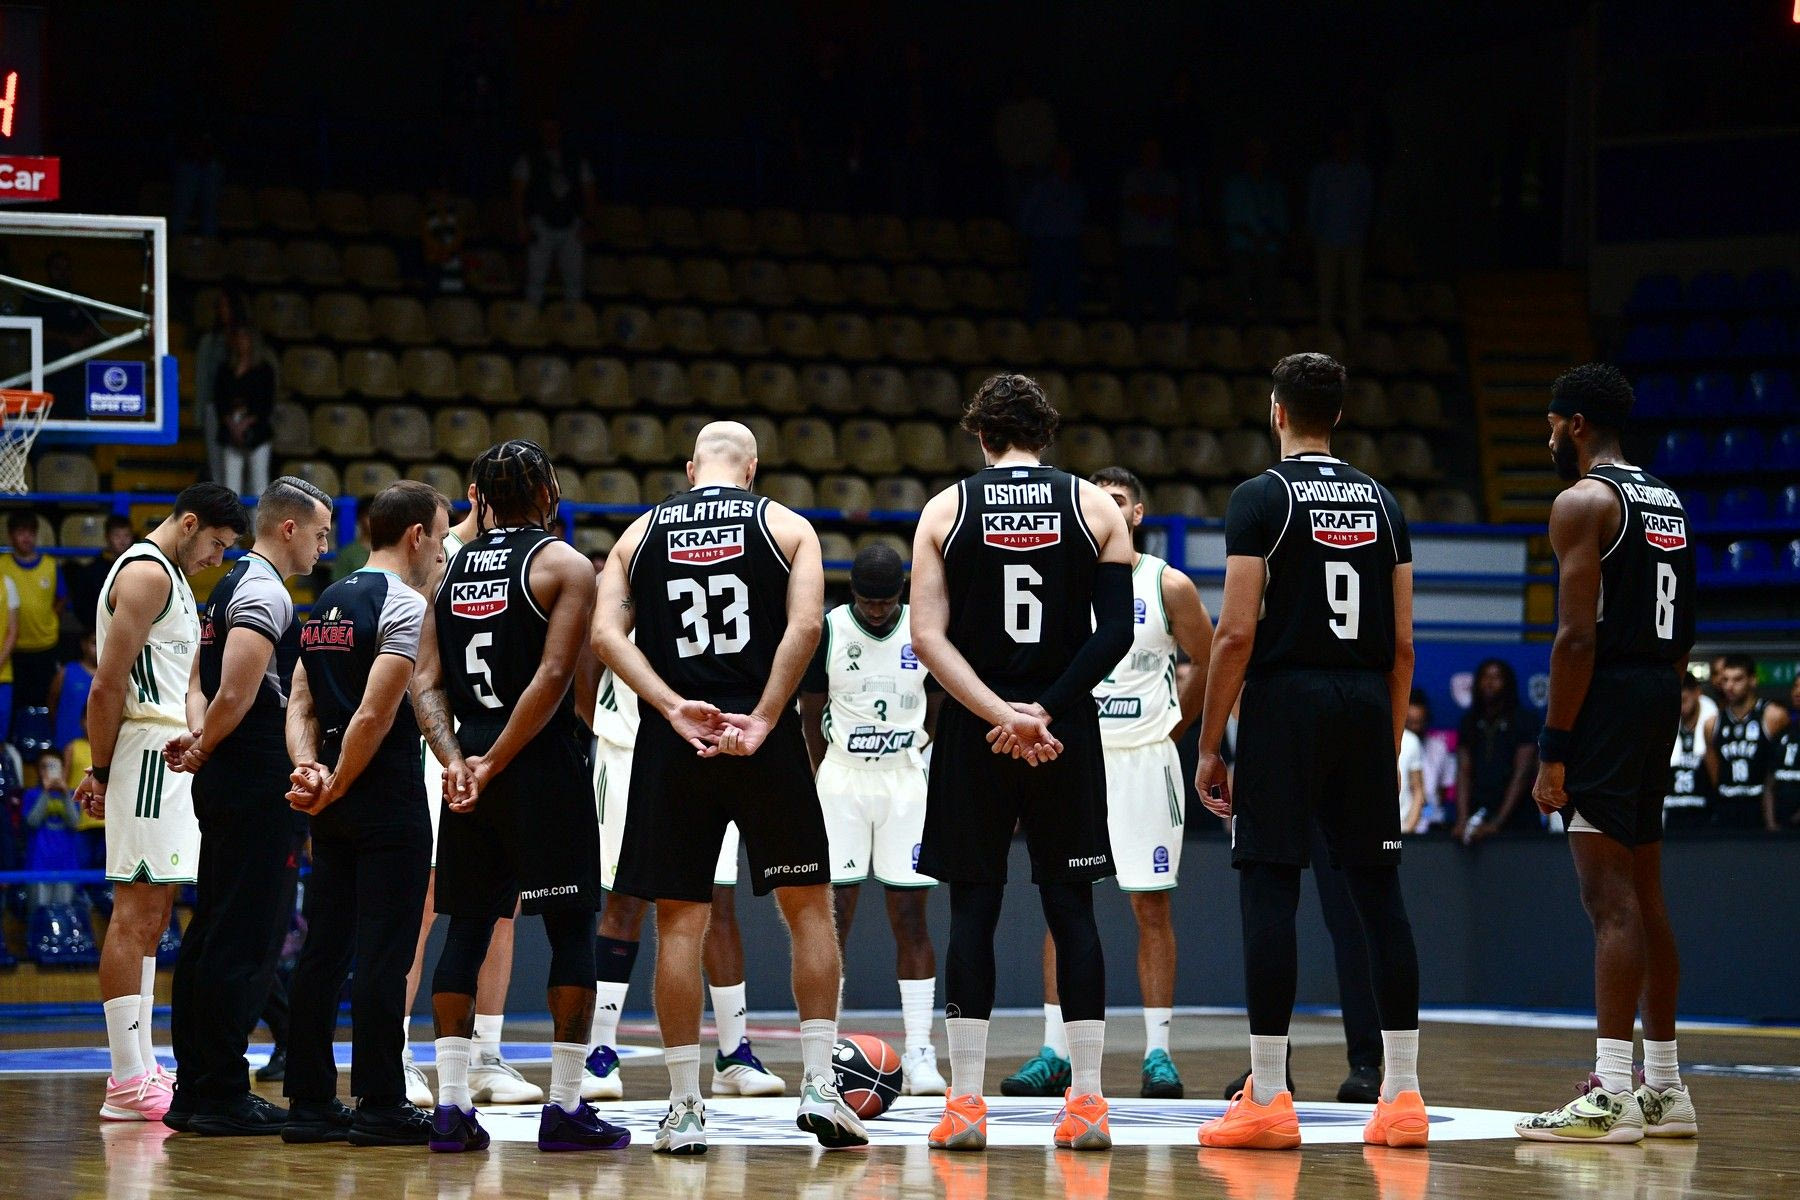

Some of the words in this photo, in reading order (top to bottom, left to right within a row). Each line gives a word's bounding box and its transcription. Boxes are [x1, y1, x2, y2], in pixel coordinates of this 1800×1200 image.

[0, 164, 46, 192] Car
[984, 483, 1052, 505] OSMAN
[1291, 481, 1378, 503] CHOUGKAZ
[658, 499, 754, 525] CALATHES
[985, 515, 1058, 531] KRAFT
[1312, 512, 1374, 529] KRAFT
[1643, 514, 1683, 534] KRAFT
[670, 527, 742, 548] KRAFT
[464, 549, 512, 573] TYREE
[688, 549, 725, 559] PAINTS
[453, 582, 508, 602] KRAFT
[1325, 561, 1360, 640] 9
[1655, 562, 1677, 640] 8
[467, 603, 495, 612] PAINTS
[1003, 564, 1043, 643] 6
[666, 573, 751, 659] 33
[465, 631, 504, 709] 5
[874, 699, 887, 722] 3
[764, 861, 819, 878] more.com
[521, 883, 578, 900] more.com
